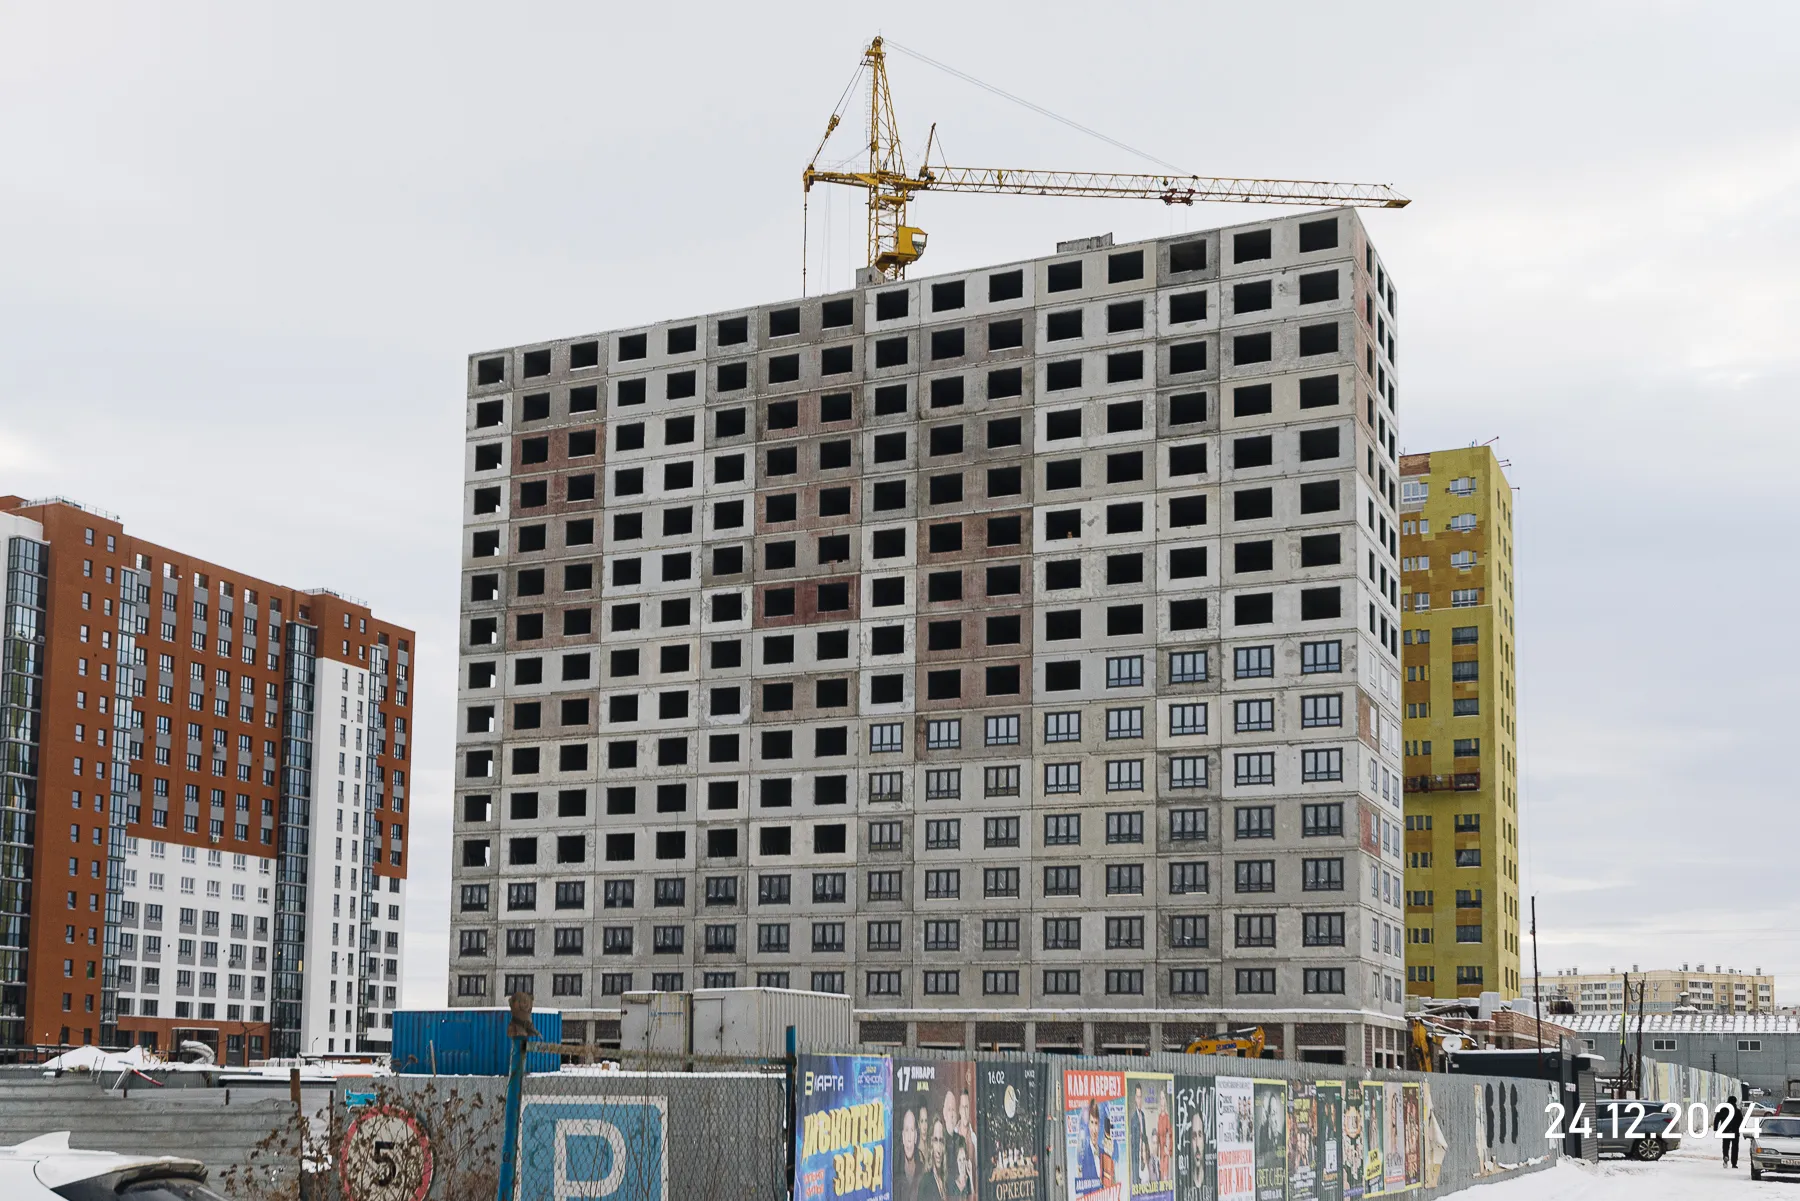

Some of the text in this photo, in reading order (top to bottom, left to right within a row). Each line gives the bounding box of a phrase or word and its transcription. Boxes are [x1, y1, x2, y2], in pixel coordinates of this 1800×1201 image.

[805, 1071, 814, 1096] 8
[897, 1066, 910, 1092] 17
[911, 1066, 935, 1079] ЯНВАРЯ
[987, 1070, 1005, 1085] 16.02
[1067, 1074, 1089, 1097] ИЛЬЯ
[800, 1101, 885, 1166] ДИСКОТЕКА
[373, 1140, 397, 1187] 5
[553, 1118, 627, 1201] P
[996, 1180, 1035, 1201] ОРКЕСТР
